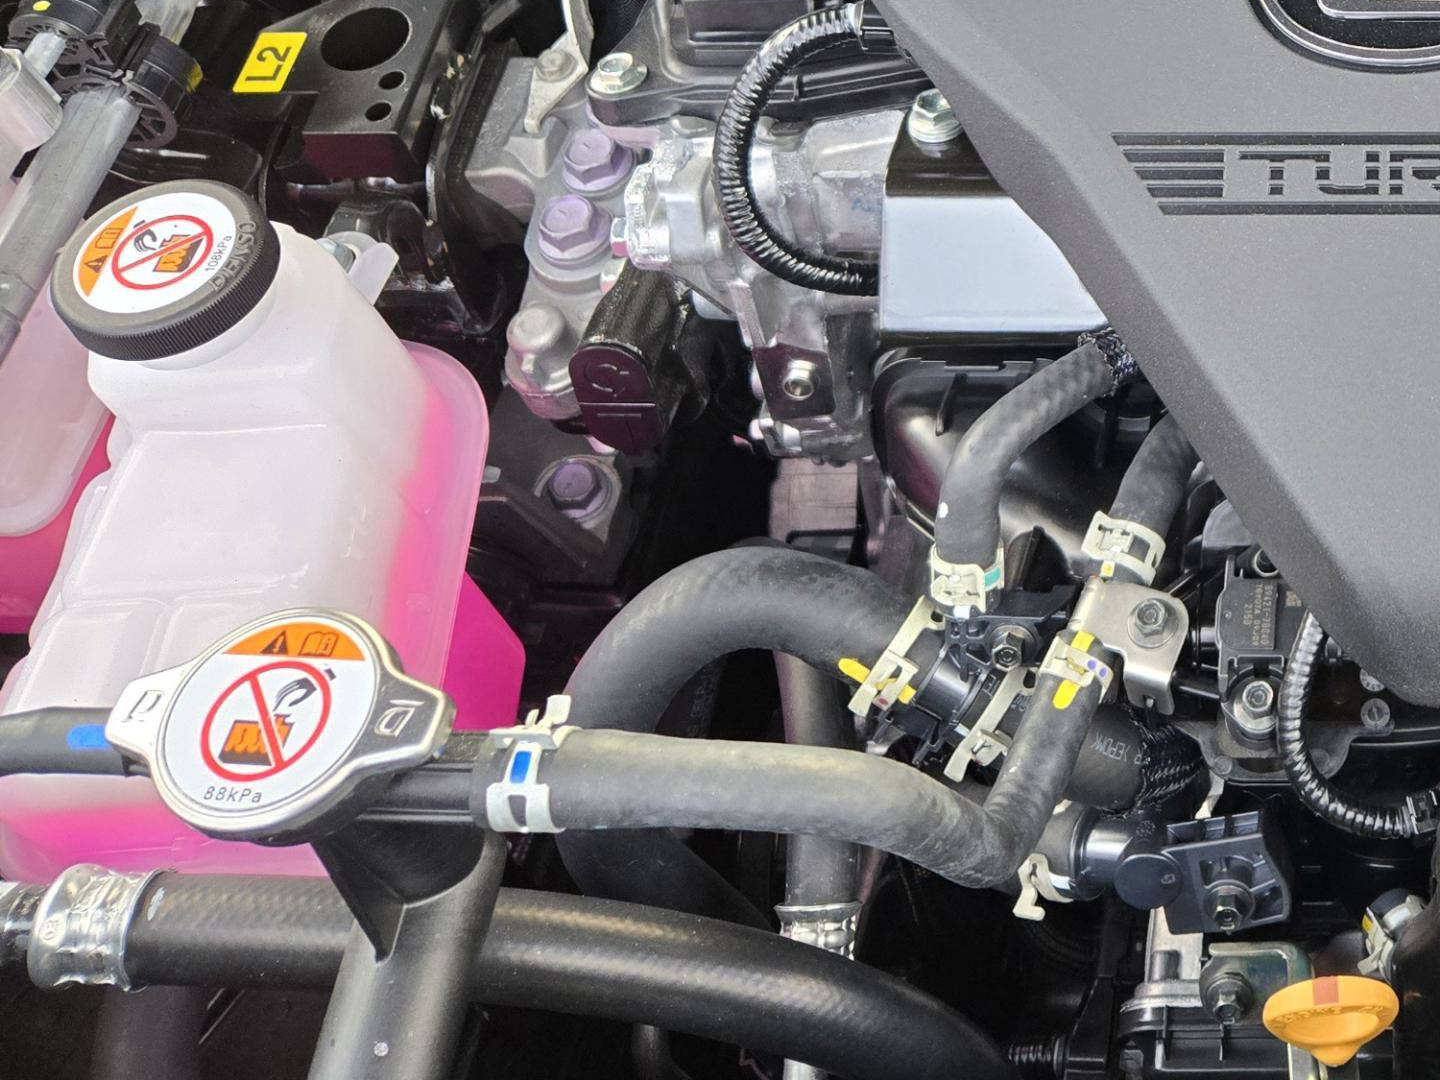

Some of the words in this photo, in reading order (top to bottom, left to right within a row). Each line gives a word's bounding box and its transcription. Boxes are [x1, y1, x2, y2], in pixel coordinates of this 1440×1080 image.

[245, 46, 293, 81] L2
[205, 235, 232, 271] 108kPa
[208, 220, 257, 291] DENSO
[203, 786, 262, 804] 88kPa
